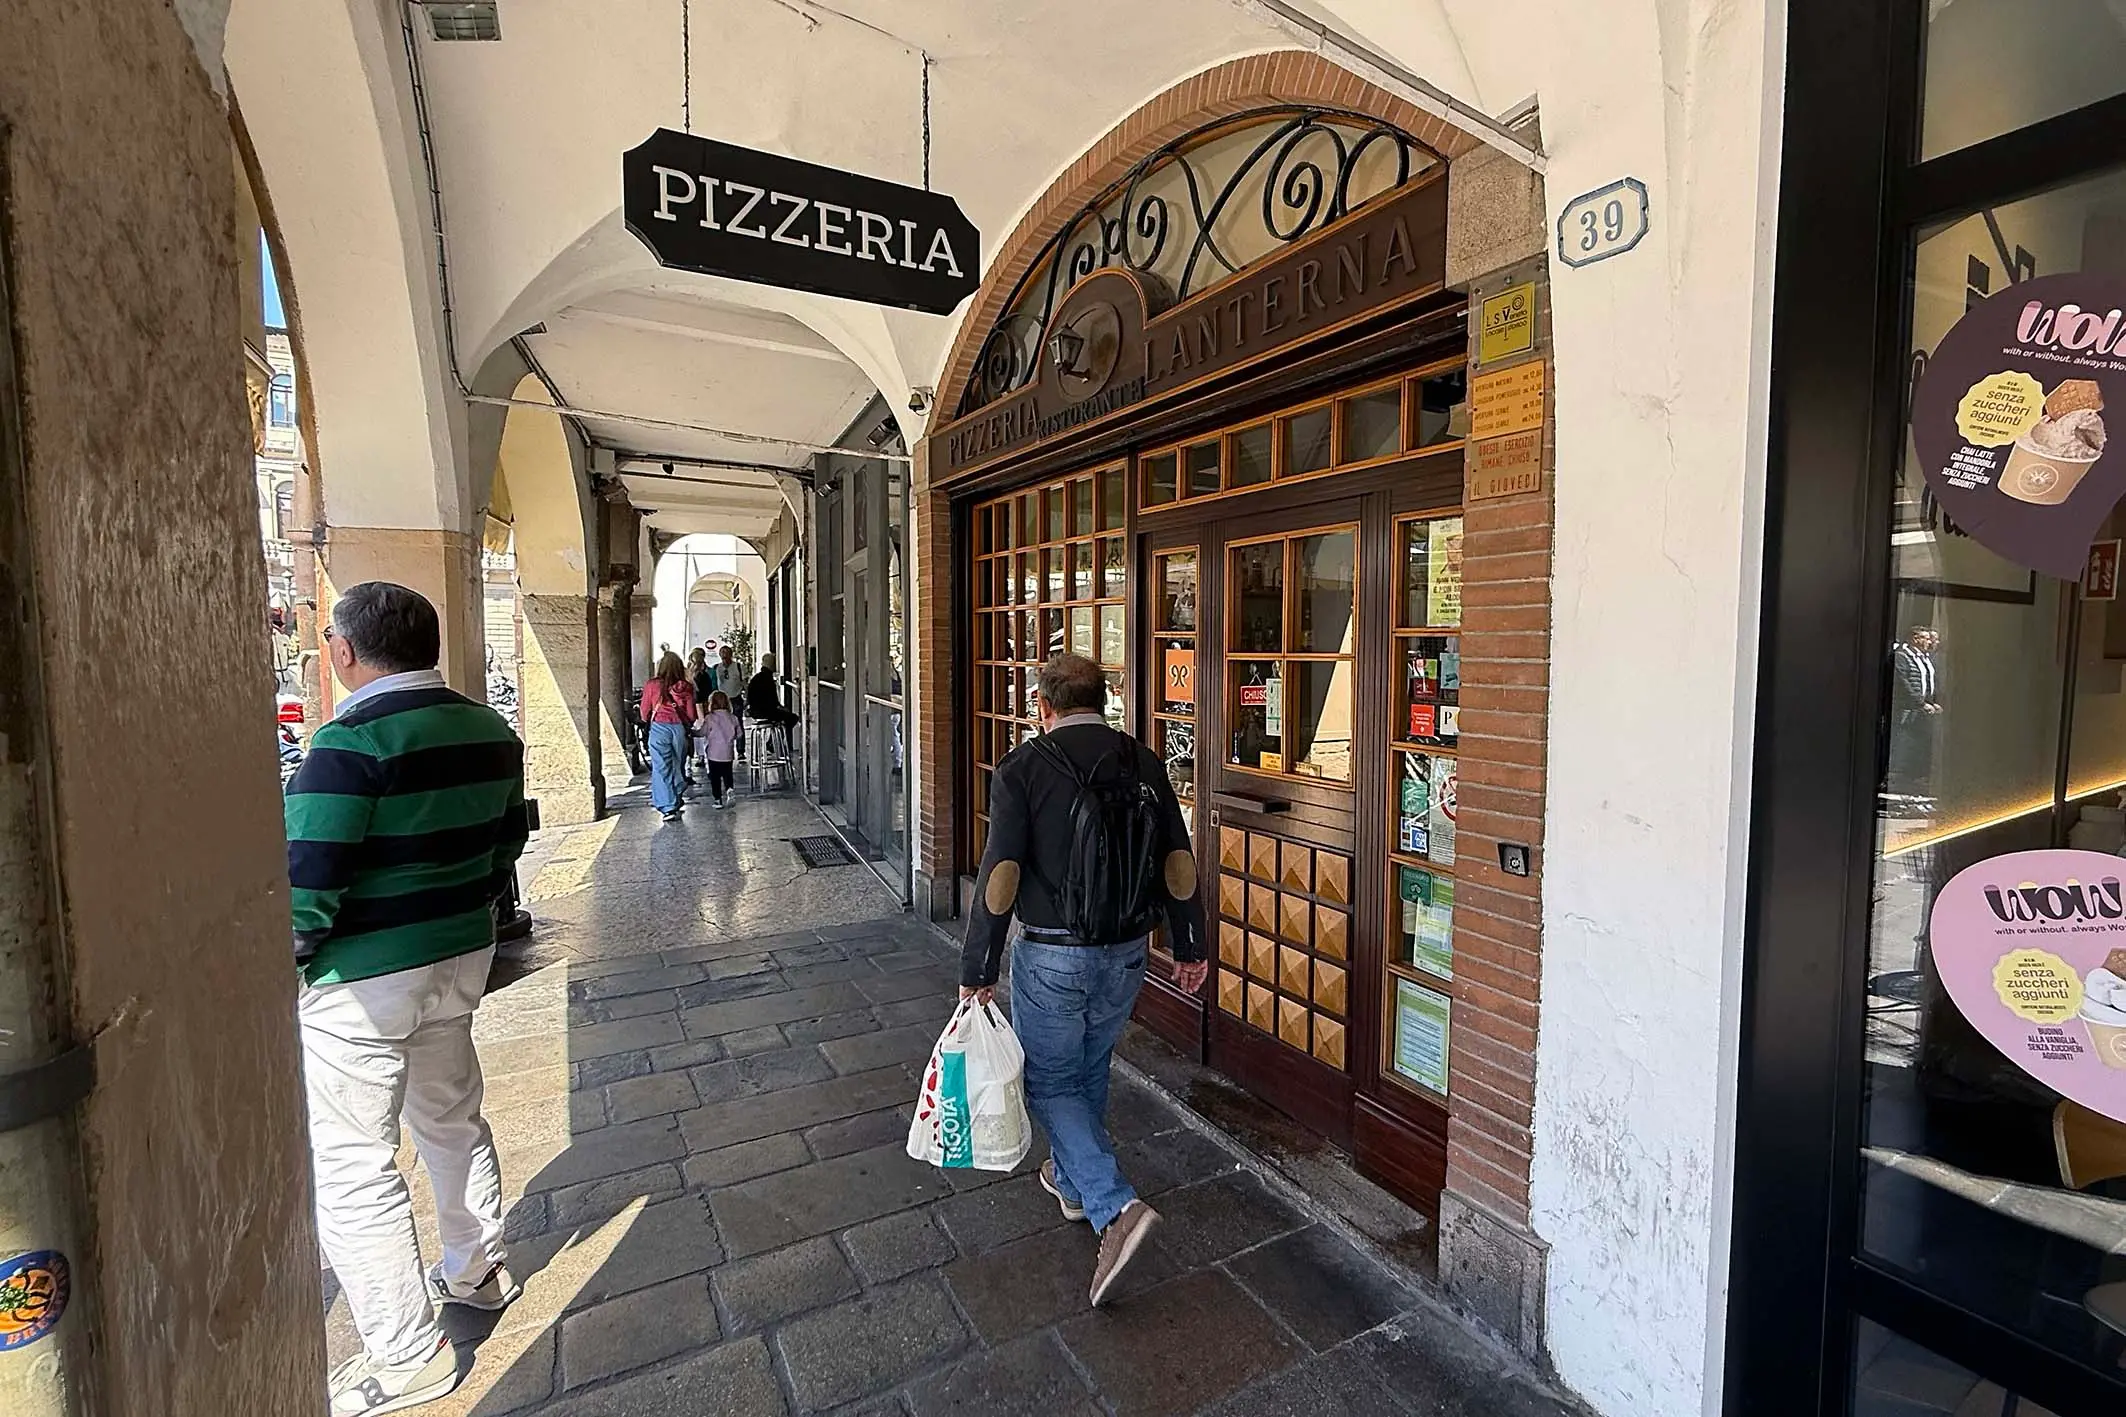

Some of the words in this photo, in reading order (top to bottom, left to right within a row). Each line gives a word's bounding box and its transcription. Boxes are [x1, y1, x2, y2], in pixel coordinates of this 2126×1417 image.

[652, 165, 964, 278] PIZZERIA
[1580, 199, 1624, 251] 39
[950, 396, 1040, 466] PIZZERIA
[1143, 214, 1417, 386] LANTERNA
[2002, 347, 2022, 356] with
[2022, 350, 2034, 358] or
[2073, 357, 2107, 369] always
[2109, 361, 2126, 371] Wo
[1986, 390, 2026, 404] senza
[1972, 399, 2032, 417] zuccheri
[1970, 409, 2023, 426] aggiunti
[1950, 452, 1963, 461] CON
[1960, 446, 1975, 455] CHAI
[1975, 449, 1995, 460] LATTE
[1941, 467, 1961, 478] SENZA
[1961, 470, 1991, 485] ZUCCHERI
[1947, 477, 1977, 490] AGGIUNTI
[1994, 926, 2015, 936] with
[2017, 927, 2027, 935] or
[2071, 925, 2106, 934] always
[2107, 923, 2126, 932] Wo
[2013, 969, 2055, 978] senza
[2006, 977, 2069, 989] zuccheri
[2012, 988, 2069, 1001] aggiunti
[2037, 1027, 2064, 1036] BUDINO
[2027, 1035, 2045, 1043] ALLA
[2027, 1043, 2050, 1052] SENZA
[2050, 1044, 2084, 1053] ZUCCHERI
[2042, 1052, 2074, 1061] AGGIUNTI
